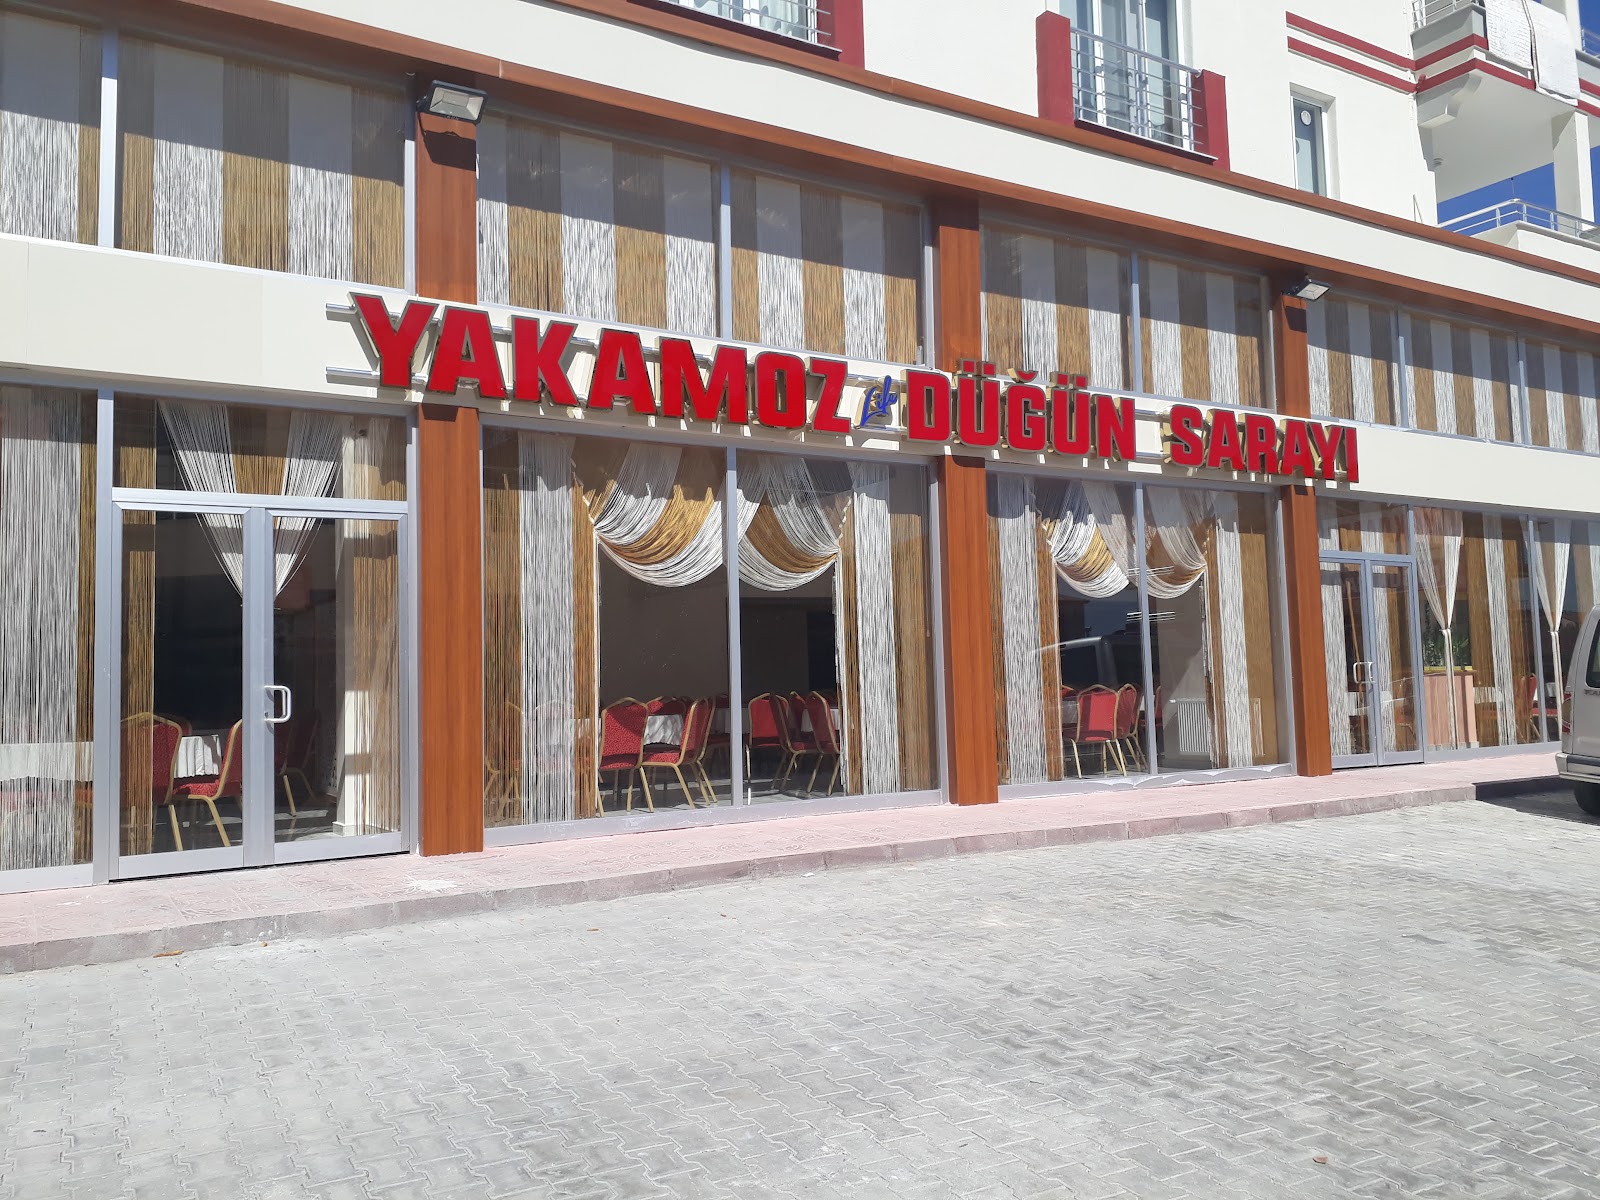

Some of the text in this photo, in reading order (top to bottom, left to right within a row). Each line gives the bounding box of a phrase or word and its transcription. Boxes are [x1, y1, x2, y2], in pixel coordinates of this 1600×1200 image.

[353, 294, 851, 433] YAKAMOZ
[906, 360, 1136, 460] DÜĞÜN
[1170, 405, 1360, 482] SARAYI
